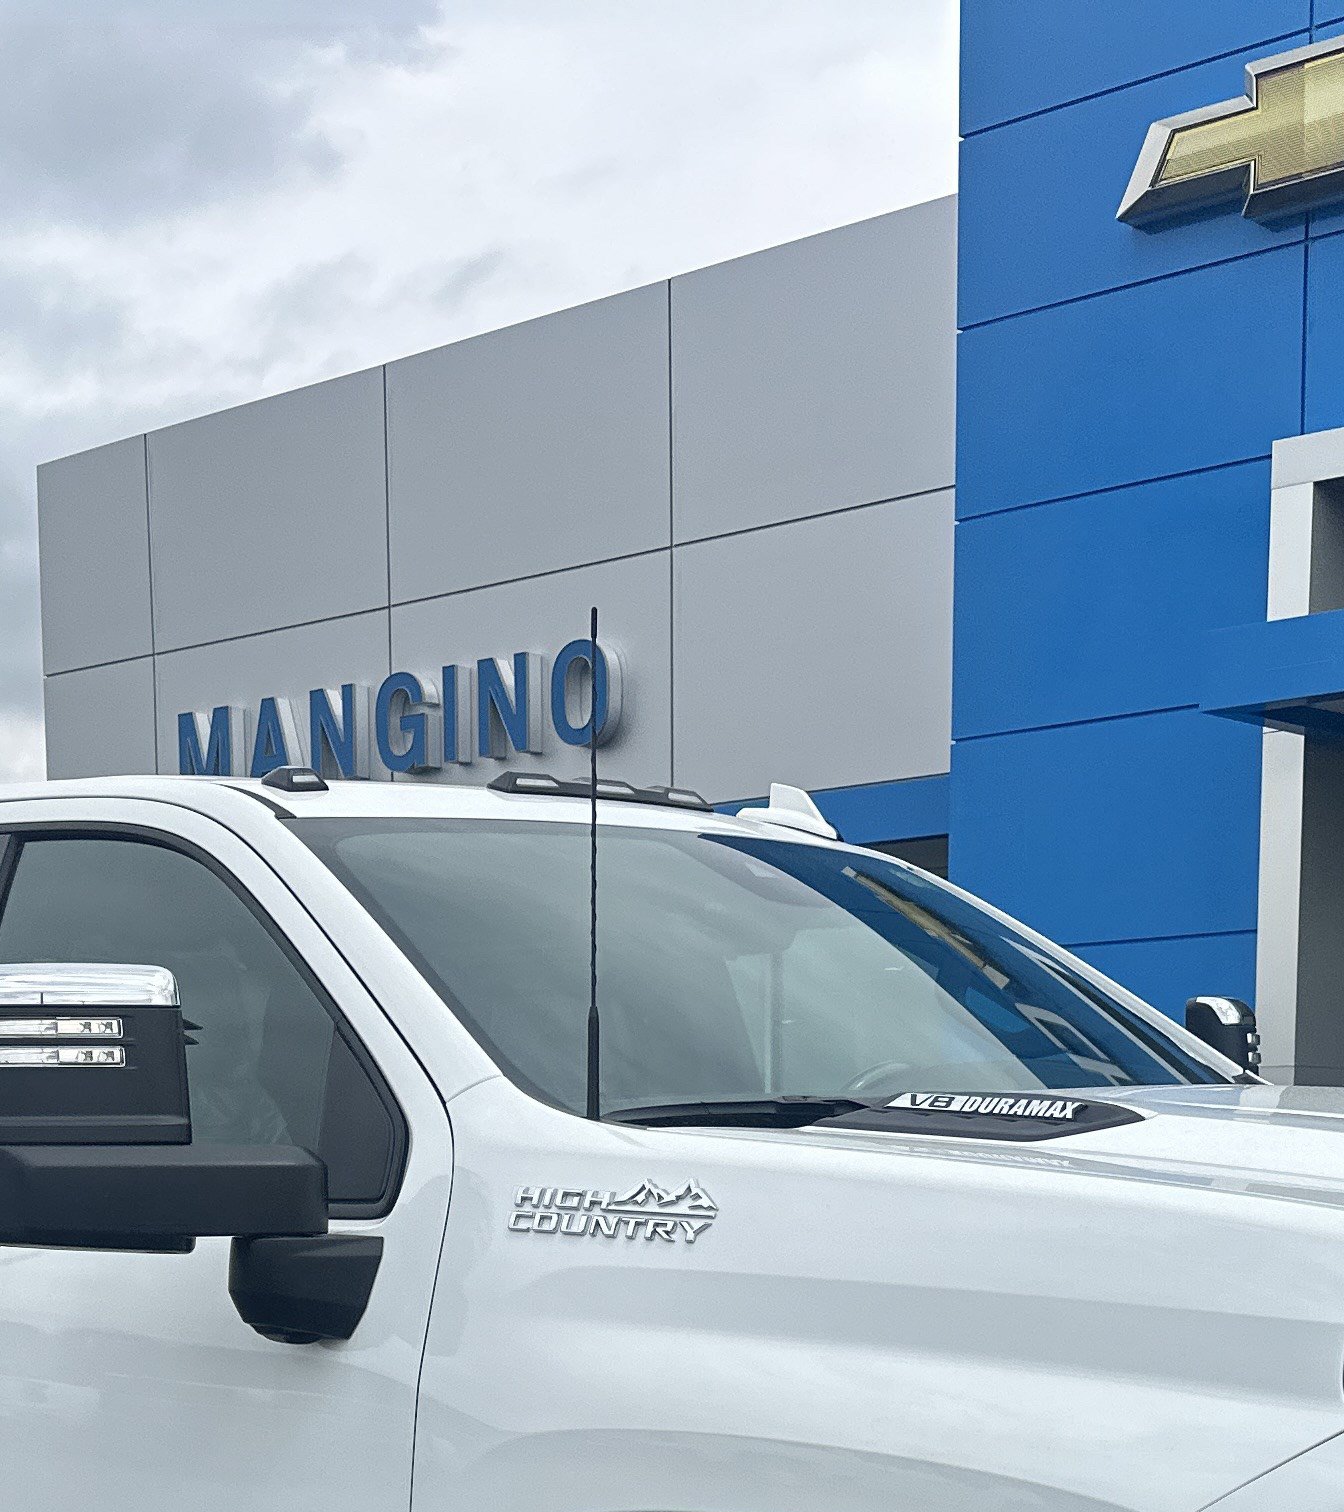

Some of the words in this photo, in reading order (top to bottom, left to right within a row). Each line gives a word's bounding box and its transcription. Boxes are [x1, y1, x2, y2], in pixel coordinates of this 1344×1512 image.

[177, 638, 618, 777] MANGINO
[910, 1093, 957, 1109] V8
[960, 1096, 1083, 1119] DURAMAX
[514, 1185, 616, 1212] HIGH
[507, 1211, 713, 1244] COUNTRY
